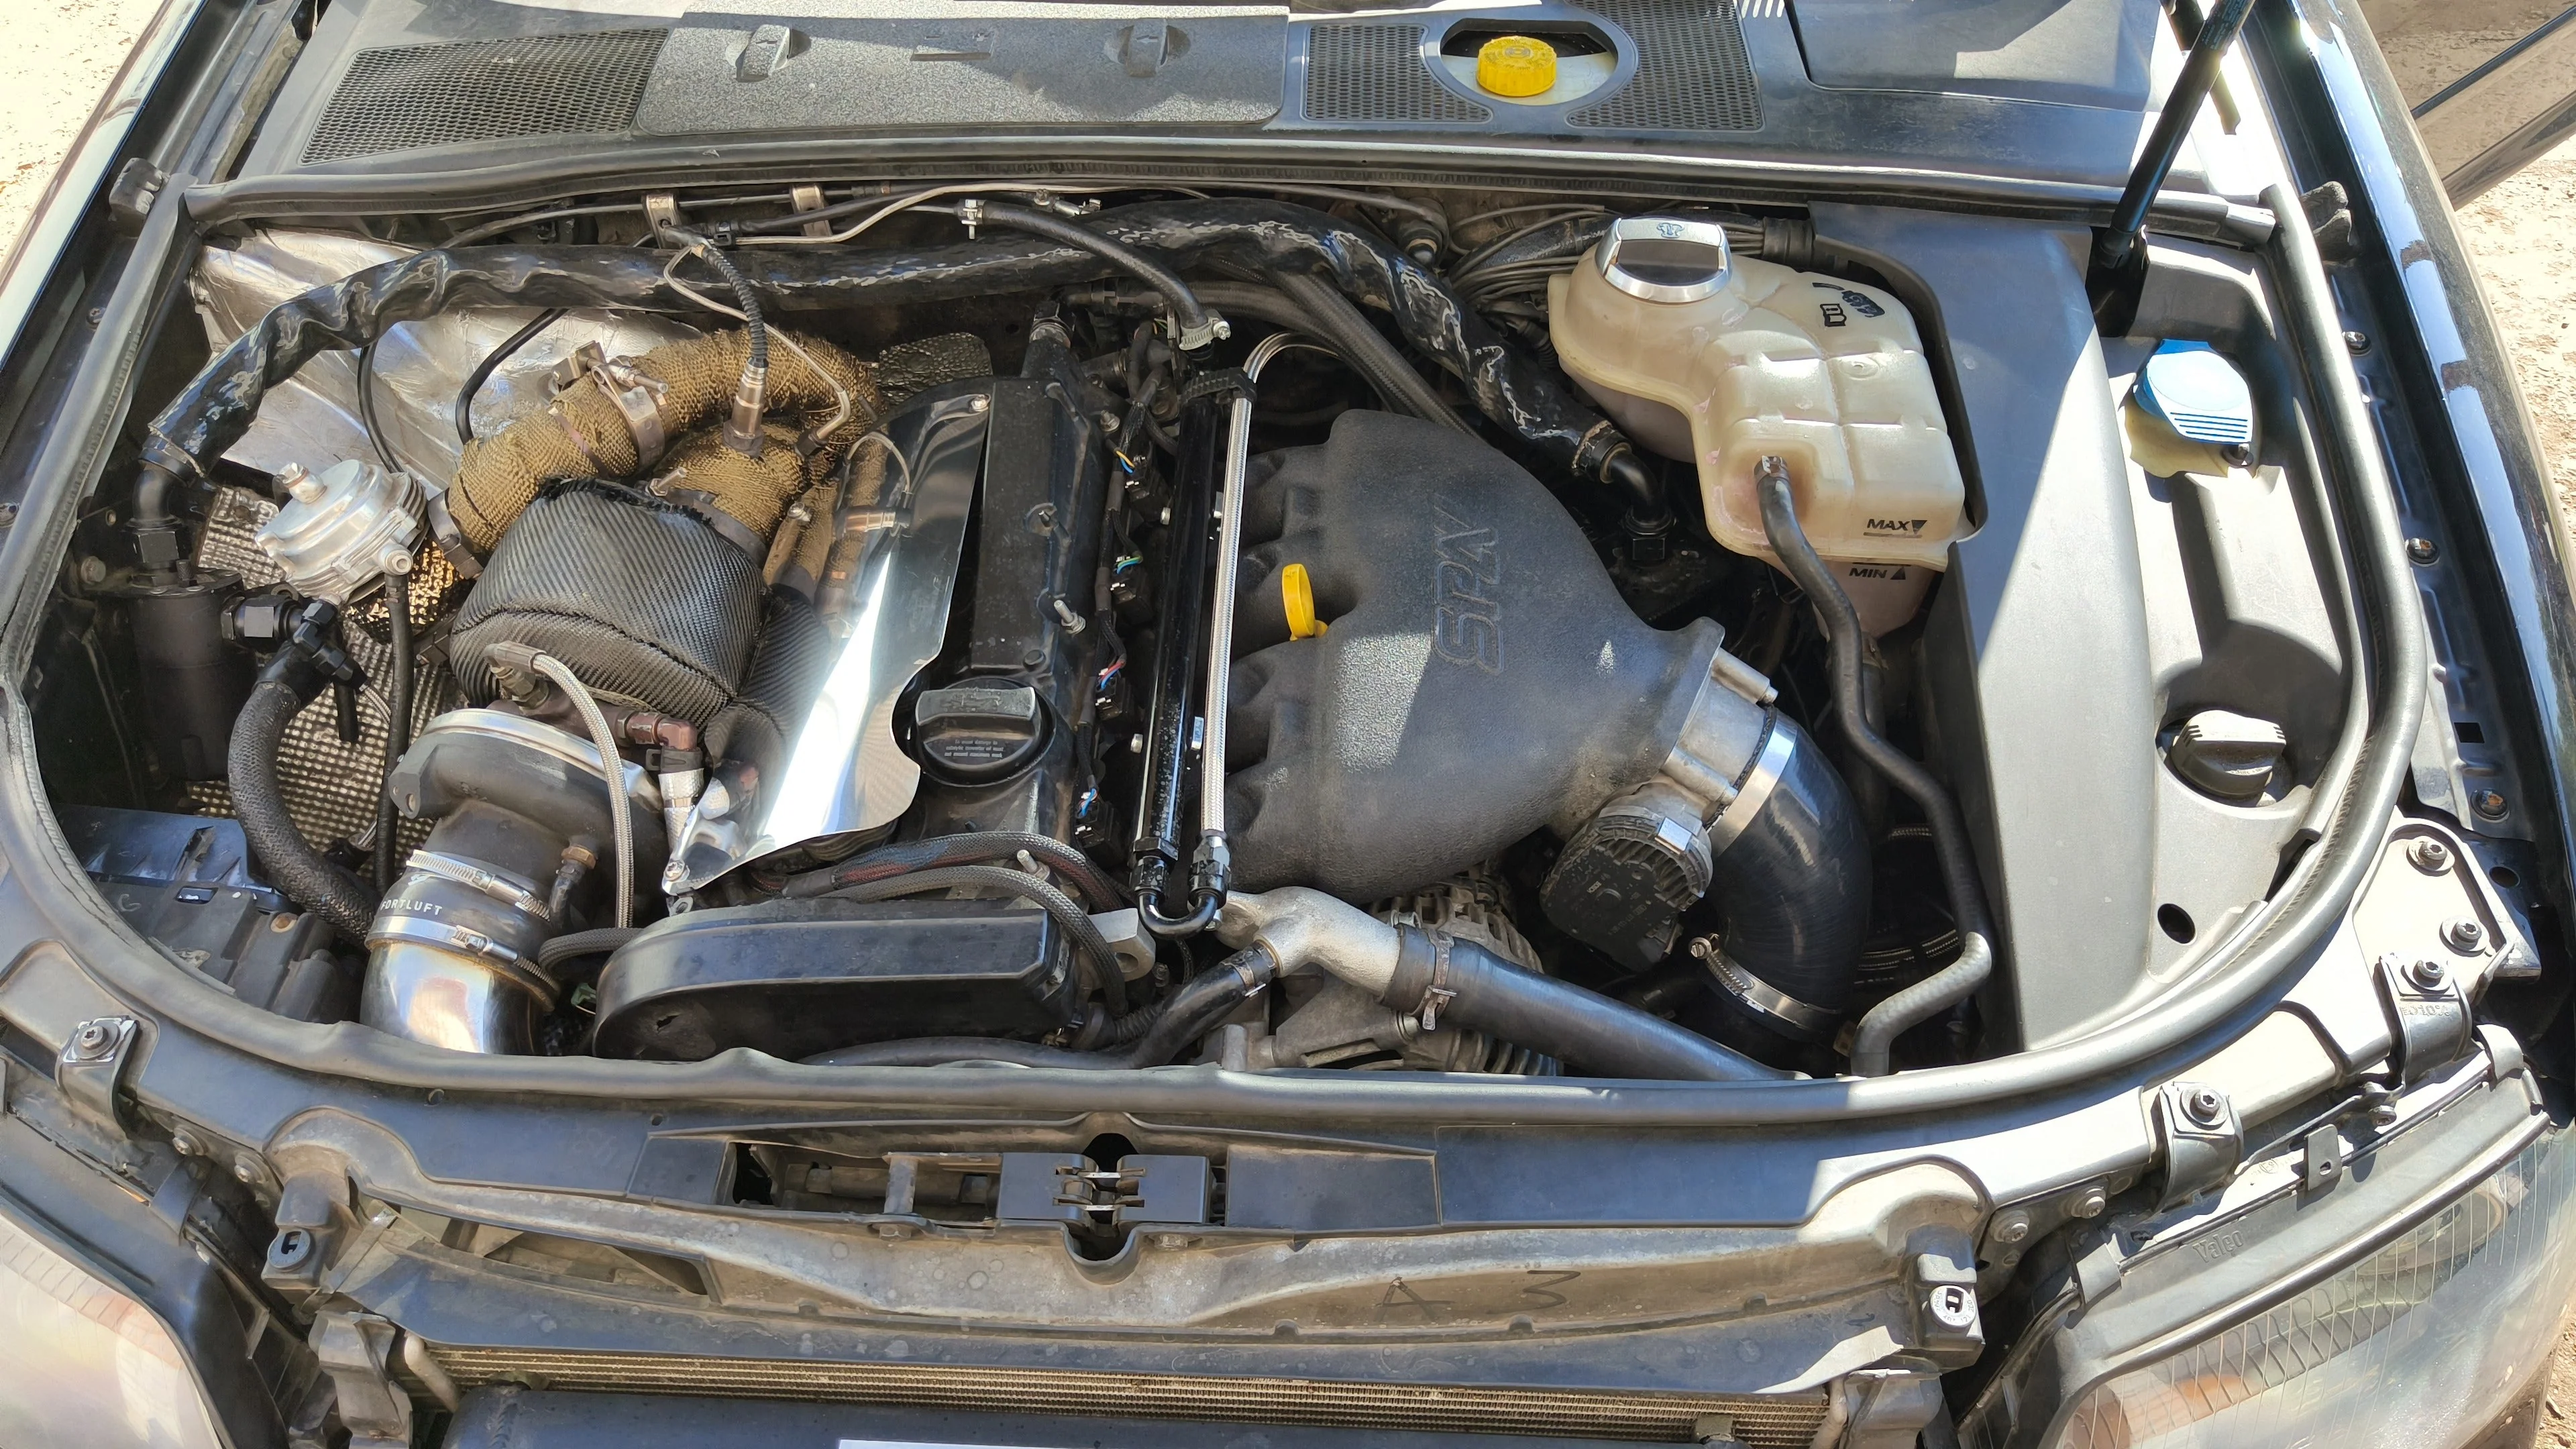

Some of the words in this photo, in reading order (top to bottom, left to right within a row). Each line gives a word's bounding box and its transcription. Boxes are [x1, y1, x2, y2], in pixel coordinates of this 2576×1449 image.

[1867, 519, 1910, 531] MAX
[1849, 568, 1887, 578] MIN
[380, 899, 443, 916] FORTLUFT
[2192, 1230, 2245, 1263] Valeo
[1375, 1276, 1456, 1323] A
[1485, 1269, 1582, 1315] 3
